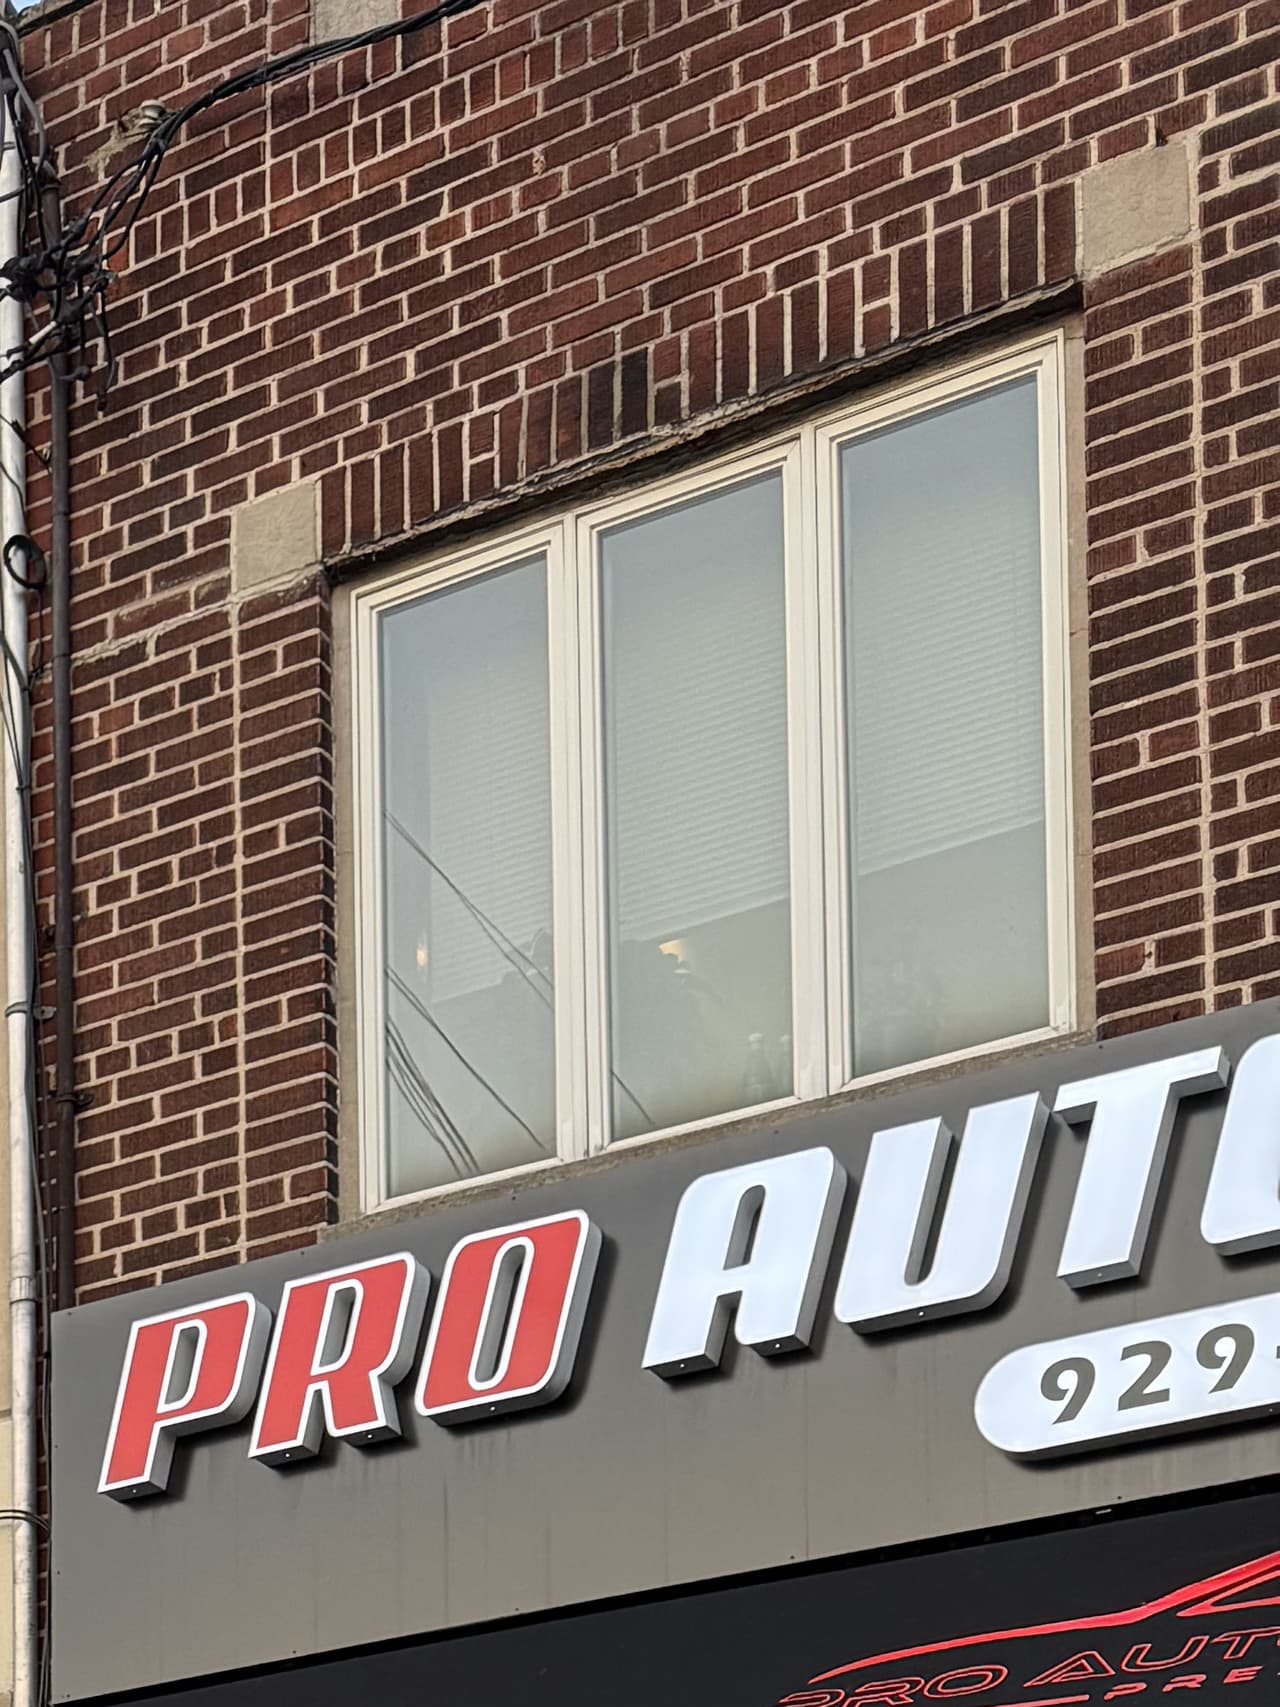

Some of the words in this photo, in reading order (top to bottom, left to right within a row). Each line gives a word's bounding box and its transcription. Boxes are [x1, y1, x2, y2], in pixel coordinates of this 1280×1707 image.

[98, 1208, 602, 1502] PRO
[1040, 1323, 1280, 1426] 929
[1023, 1626, 1280, 1688] AUT
[1103, 1666, 1280, 1701] PRE
